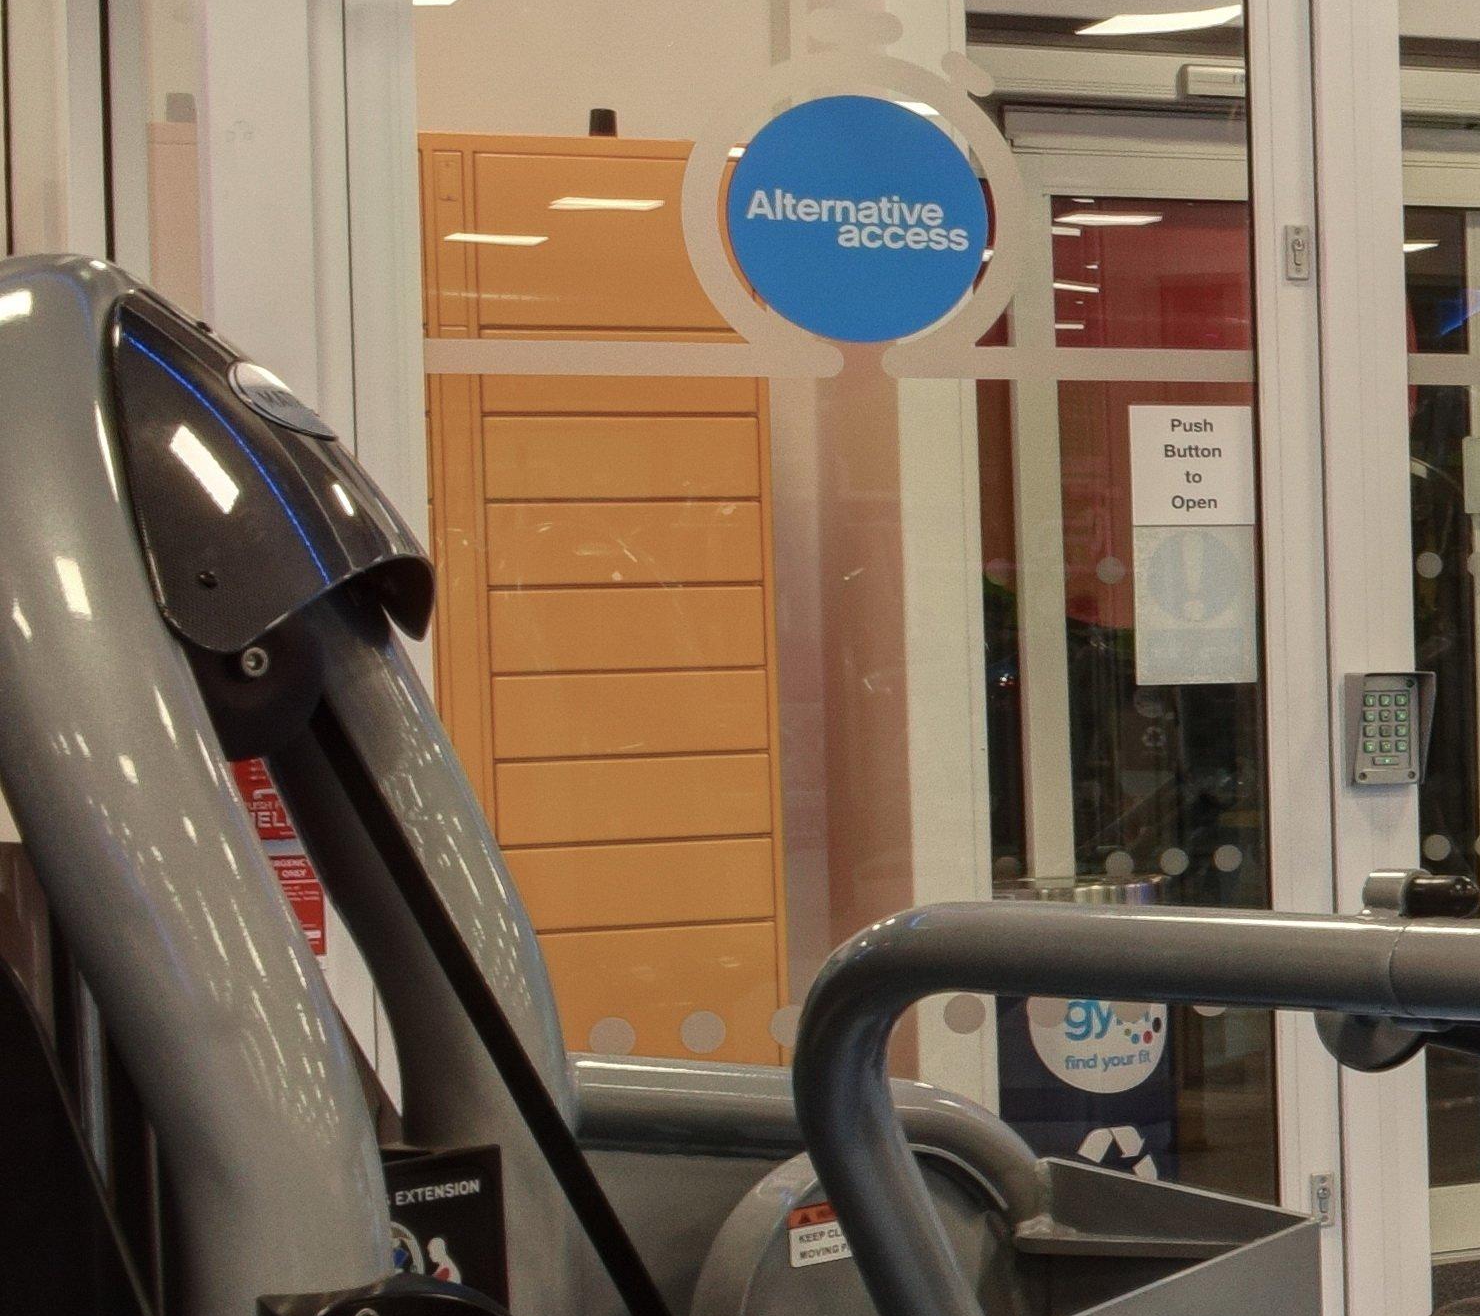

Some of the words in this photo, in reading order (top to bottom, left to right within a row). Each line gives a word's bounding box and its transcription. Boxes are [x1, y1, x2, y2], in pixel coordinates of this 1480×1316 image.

[746, 187, 944, 227] Alternative
[837, 224, 970, 252] access
[1170, 418, 1214, 433] Push
[1163, 444, 1222, 458] Button
[1184, 470, 1202, 484] to
[1171, 495, 1217, 512] Open
[1065, 1054, 1098, 1070] find
[1102, 1053, 1135, 1072] your
[1138, 1049, 1151, 1065] fit
[395, 1179, 481, 1206] EXTENSION
[799, 1230, 825, 1243] KEEP
